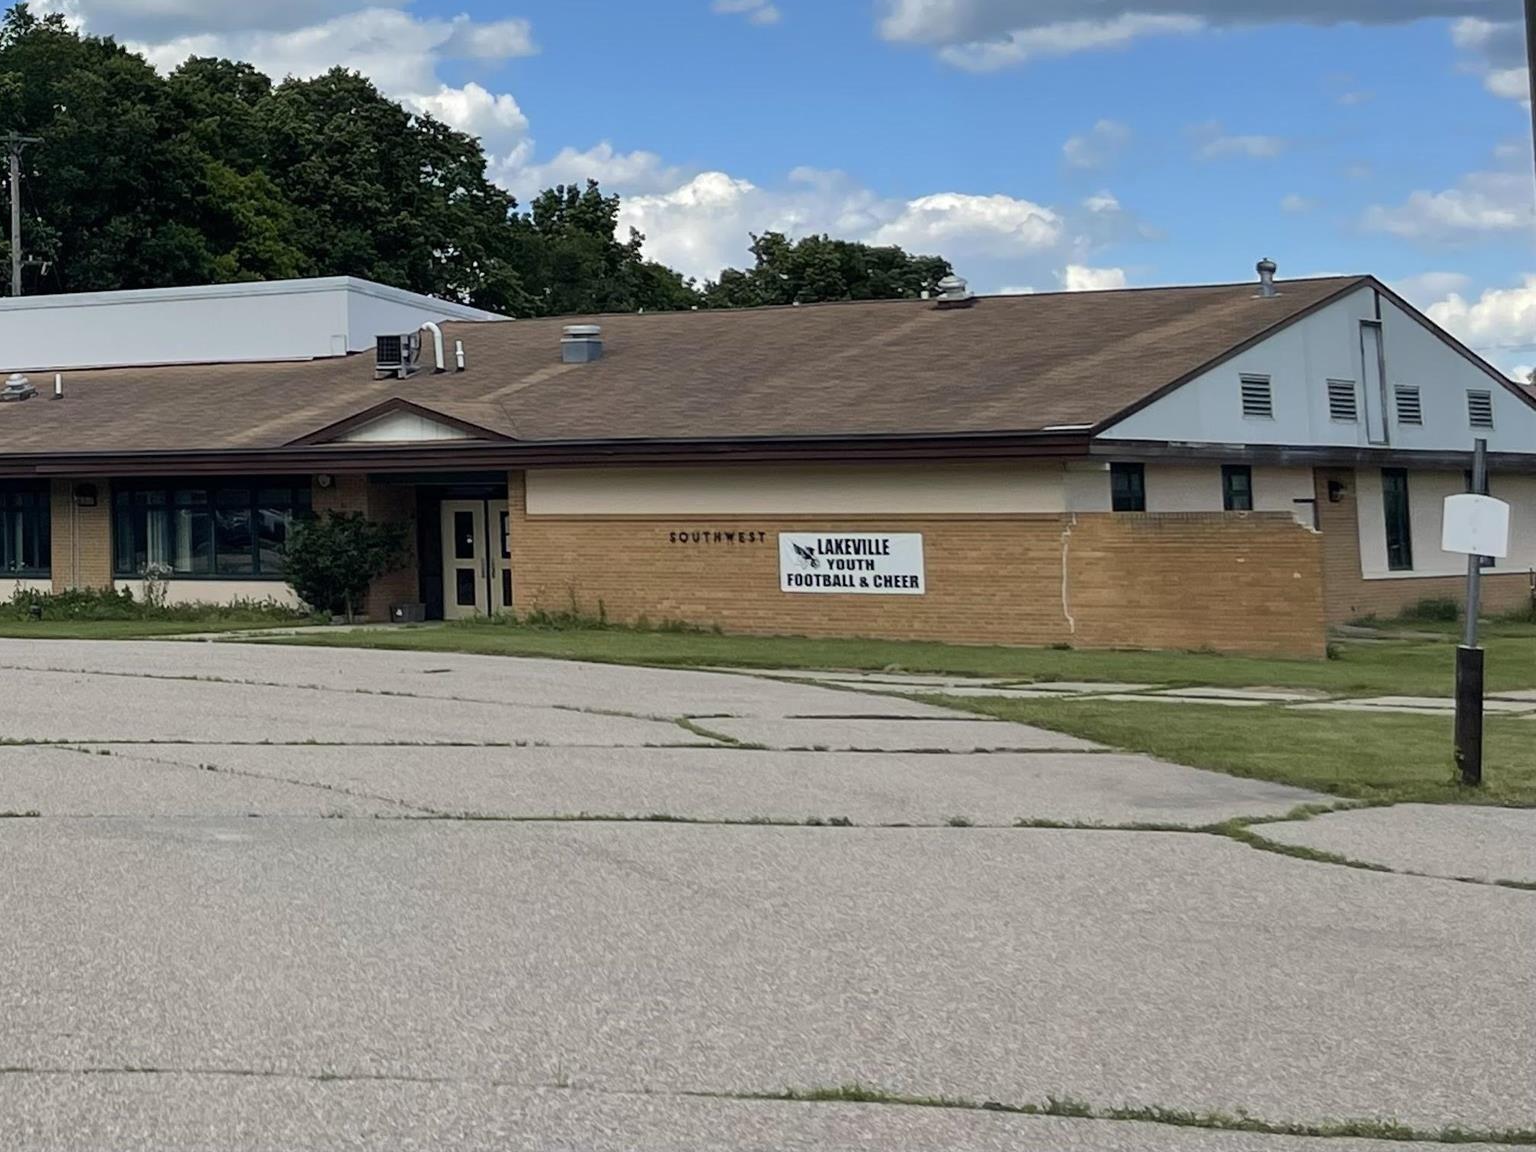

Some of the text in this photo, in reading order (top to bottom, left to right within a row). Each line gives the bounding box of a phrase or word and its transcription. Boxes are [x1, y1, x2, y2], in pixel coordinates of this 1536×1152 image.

[669, 531, 766, 543] SOUTHWEST
[817, 538, 890, 556] LAKEVILLE
[827, 559, 875, 571] YOUTH
[787, 573, 919, 589] FOOTBALL & CHEER
